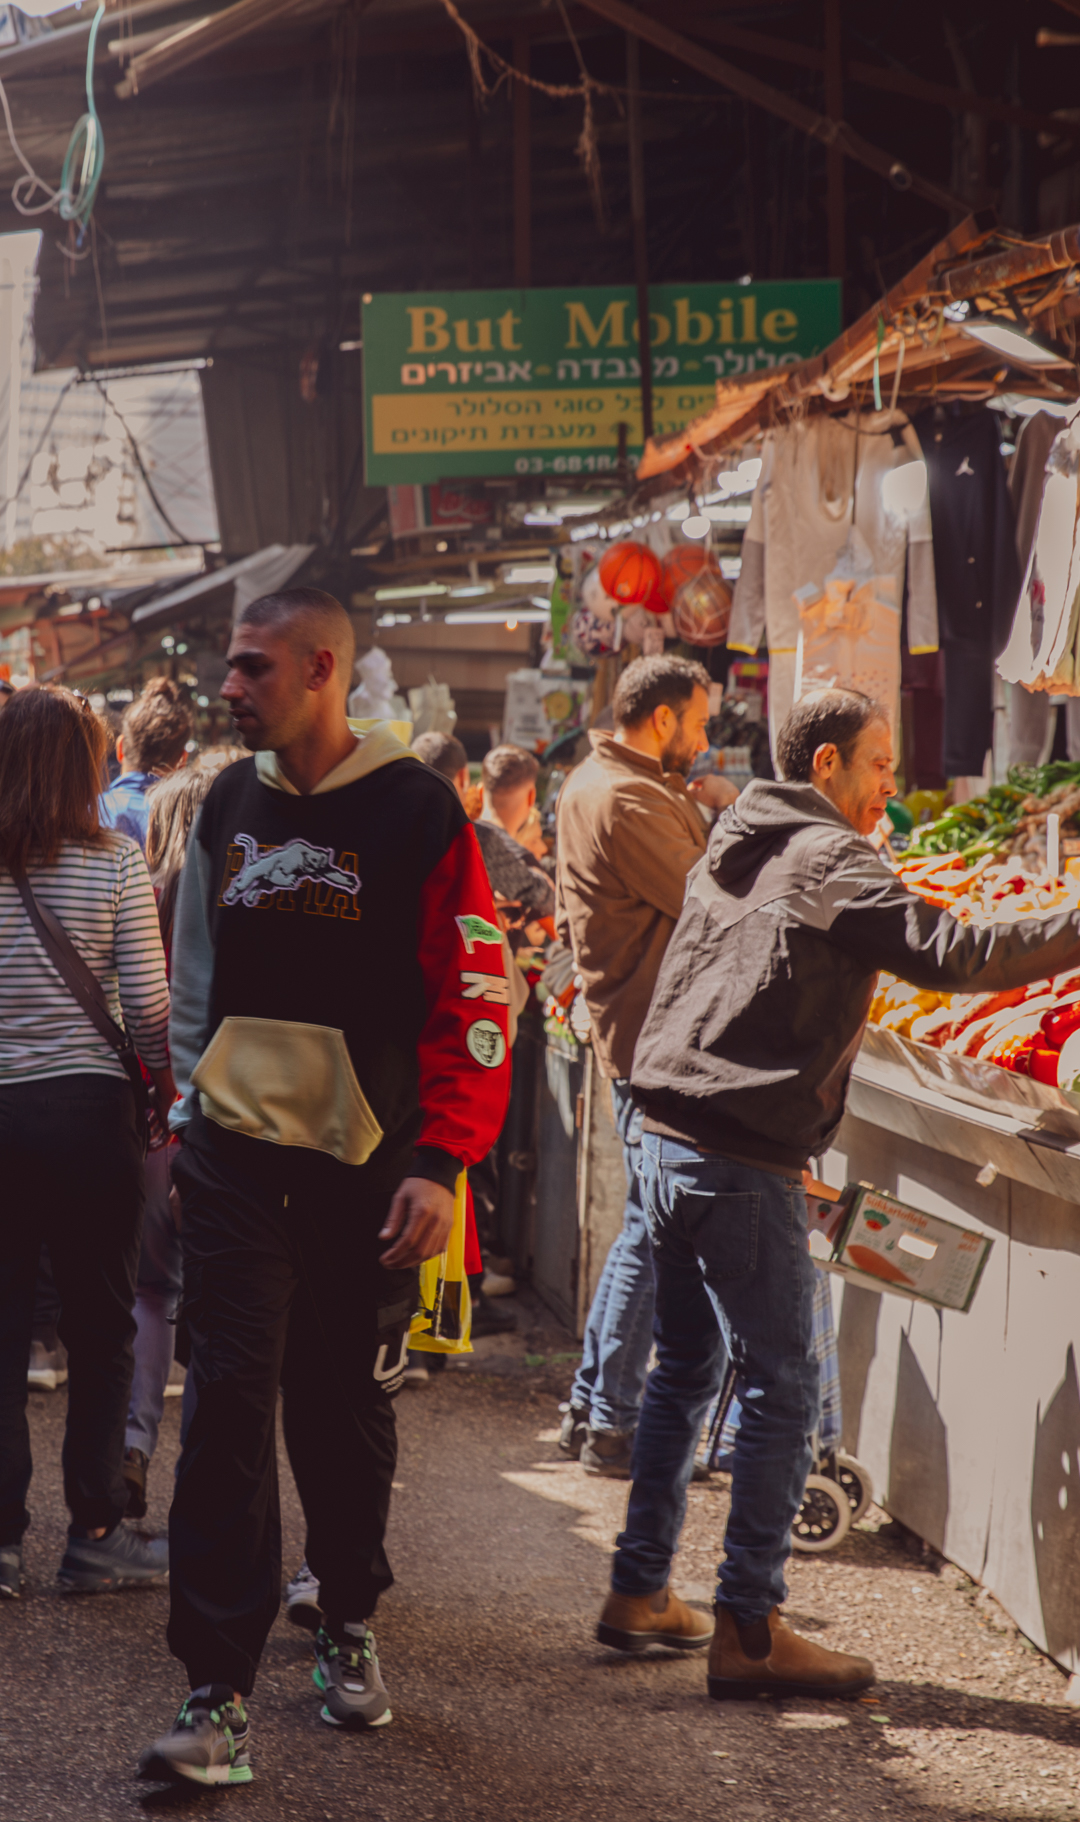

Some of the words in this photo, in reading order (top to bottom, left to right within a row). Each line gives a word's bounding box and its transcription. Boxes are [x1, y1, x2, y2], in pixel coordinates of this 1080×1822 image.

[405, 305, 523, 353] But
[564, 295, 799, 349] Mobile
[446, 397, 542, 417] הסלולר
[554, 398, 604, 415] סוגי
[391, 425, 489, 446] תיקונים
[500, 422, 596, 441] מעבדת
[217, 843, 363, 922] PA
